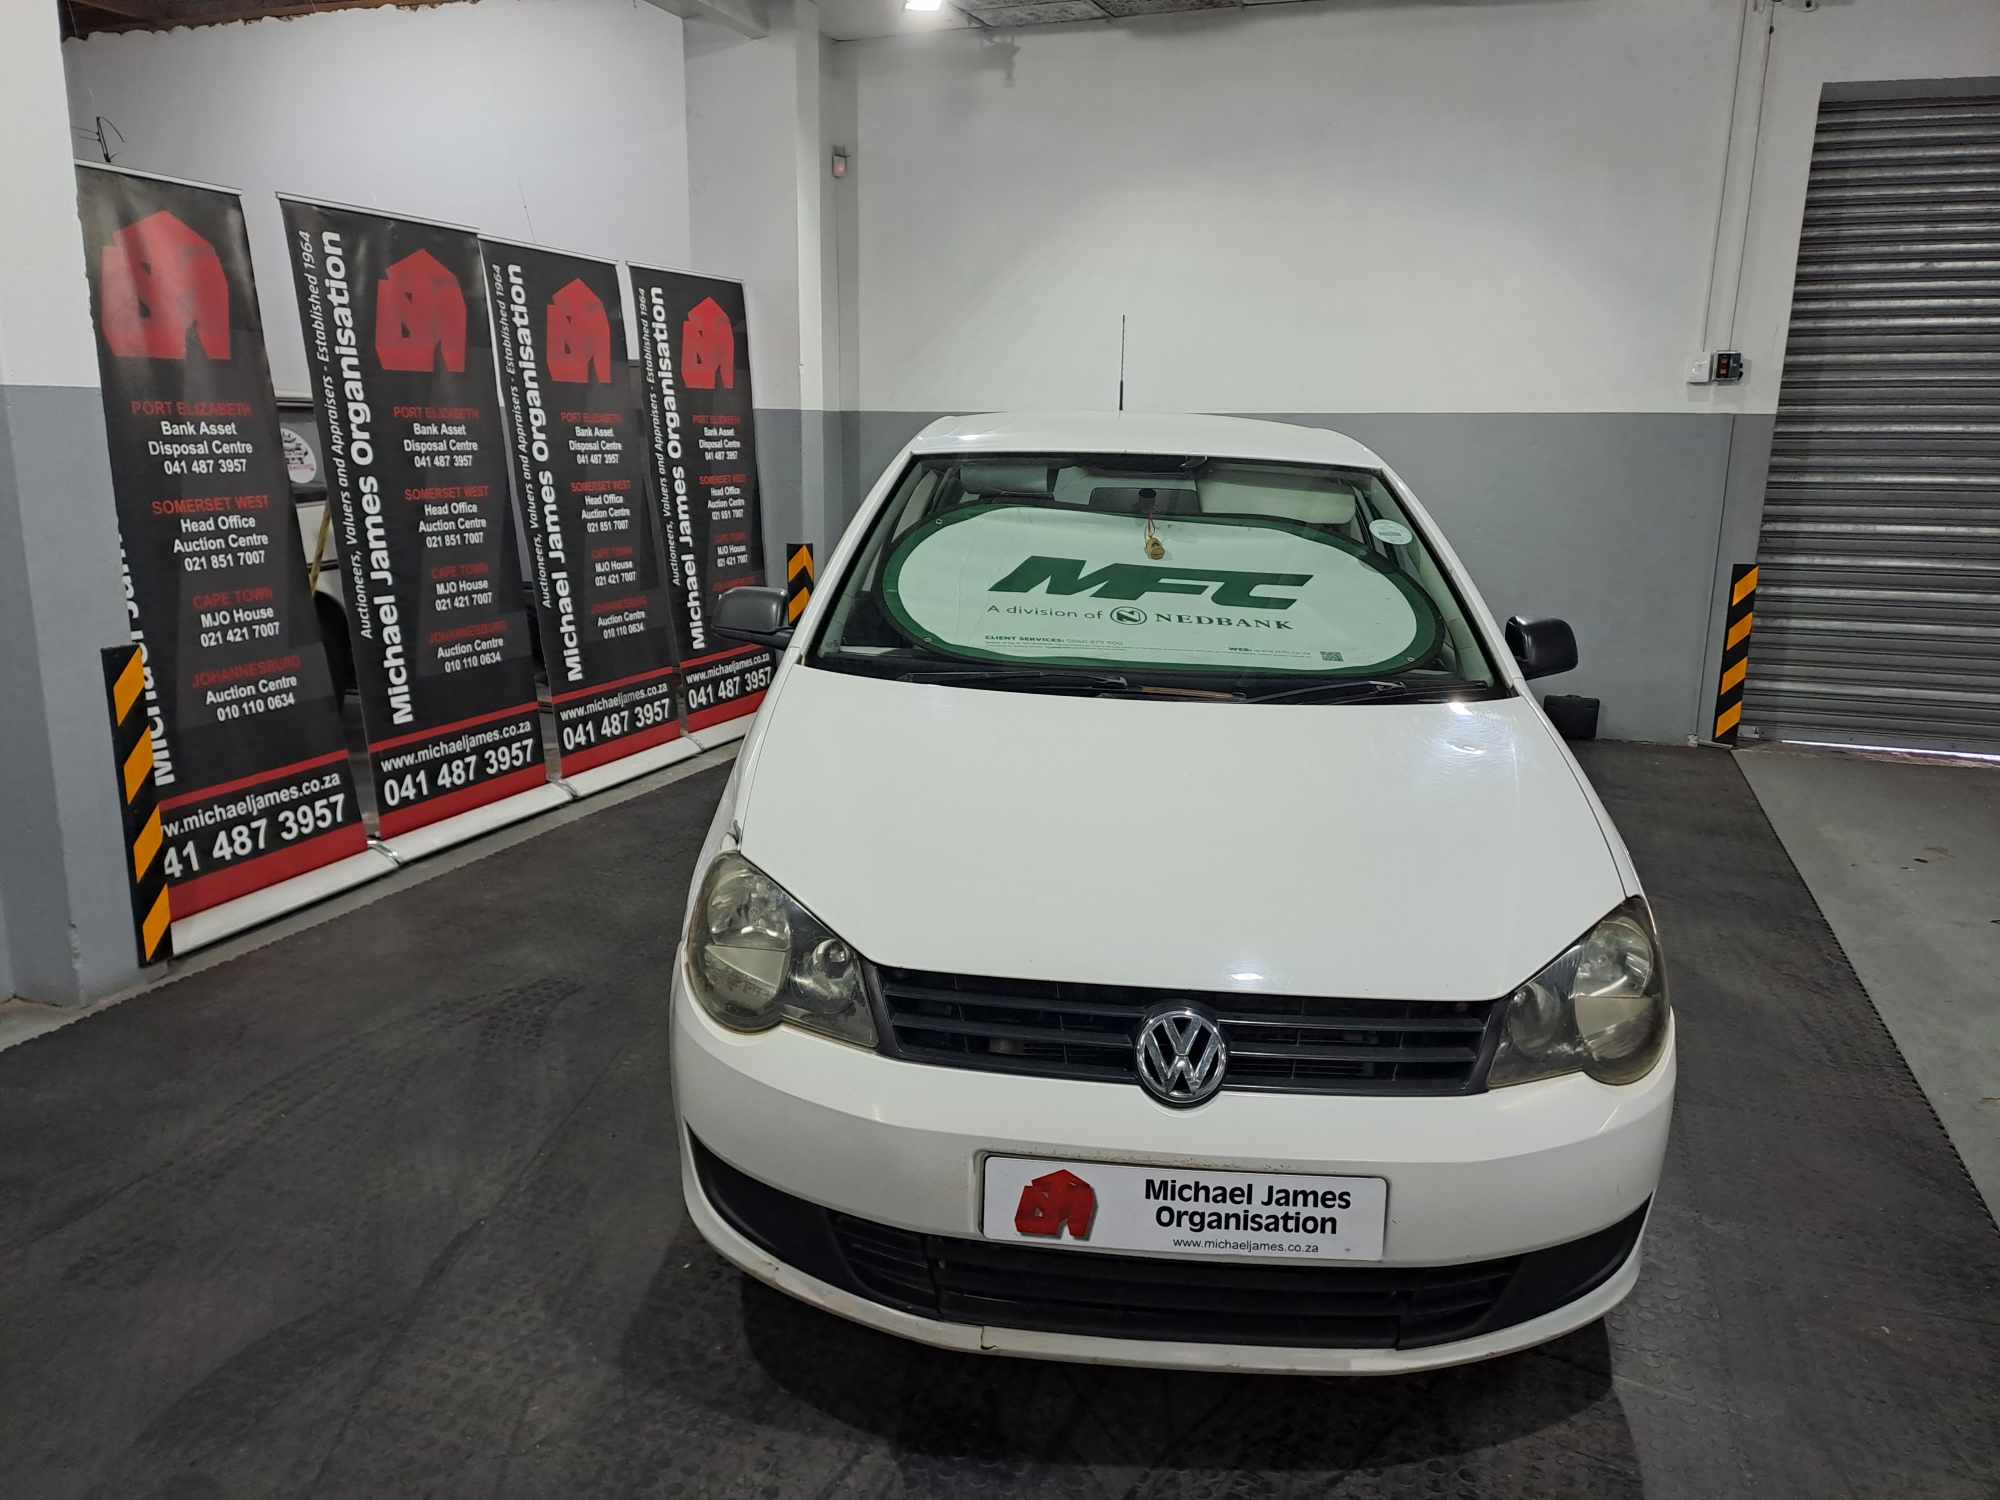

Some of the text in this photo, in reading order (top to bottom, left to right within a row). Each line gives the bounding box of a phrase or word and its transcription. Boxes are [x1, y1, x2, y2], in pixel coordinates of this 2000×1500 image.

[130, 401, 172, 416] PORT
[161, 421, 237, 436] Bank Asset
[298, 230, 374, 640] Auctioneers, Valuers and Appraisers Established 1964
[413, 423, 467, 435] Bank Asset
[148, 440, 253, 458] Disposal Centre
[404, 439, 478, 453] Disposal Centre
[164, 459, 247, 475] 041 487 3957
[414, 454, 473, 467] 041 487 3957
[650, 286, 706, 650] Michael James Organisation
[321, 230, 414, 726] Michael James Organisation
[508, 264, 583, 682] Michael James Organisation
[152, 495, 269, 514] SOMERSET WEST
[424, 501, 478, 516] Head Office
[581, 509, 608, 520] Auction
[180, 514, 256, 533] Head Office
[418, 517, 487, 533] Auction Centre
[173, 533, 269, 553] Auction Centre
[425, 532, 484, 548] 021 851 7007
[184, 550, 265, 572] 021 851 7007
[436, 579, 489, 595] MJO House
[987, 555, 1314, 610] MFC
[435, 592, 493, 611] 021 421 7007
[200, 607, 274, 628] MJO House
[987, 604, 1294, 631] A division of NEDBANK
[200, 622, 280, 647] 021 421 7007
[437, 637, 504, 659] Auction Centre
[444, 651, 502, 673] 010 110 0634
[206, 675, 297, 705] Auction Centre
[688, 666, 772, 709] 041 487 3957
[217, 692, 296, 721] 010 110 0634
[560, 682, 668, 721] www.michaeljames.co.za
[562, 698, 670, 750] 041 487 3957
[381, 720, 531, 773] www.michaeljames.co.za
[383, 738, 534, 806] 041 487 3957
[164, 793, 346, 879] 41 487 3957
[1145, 1178, 1352, 1210] Michael James
[1155, 1205, 1338, 1235] Organisation
[1172, 1237, 1319, 1253] www.michaeljames.co.za
